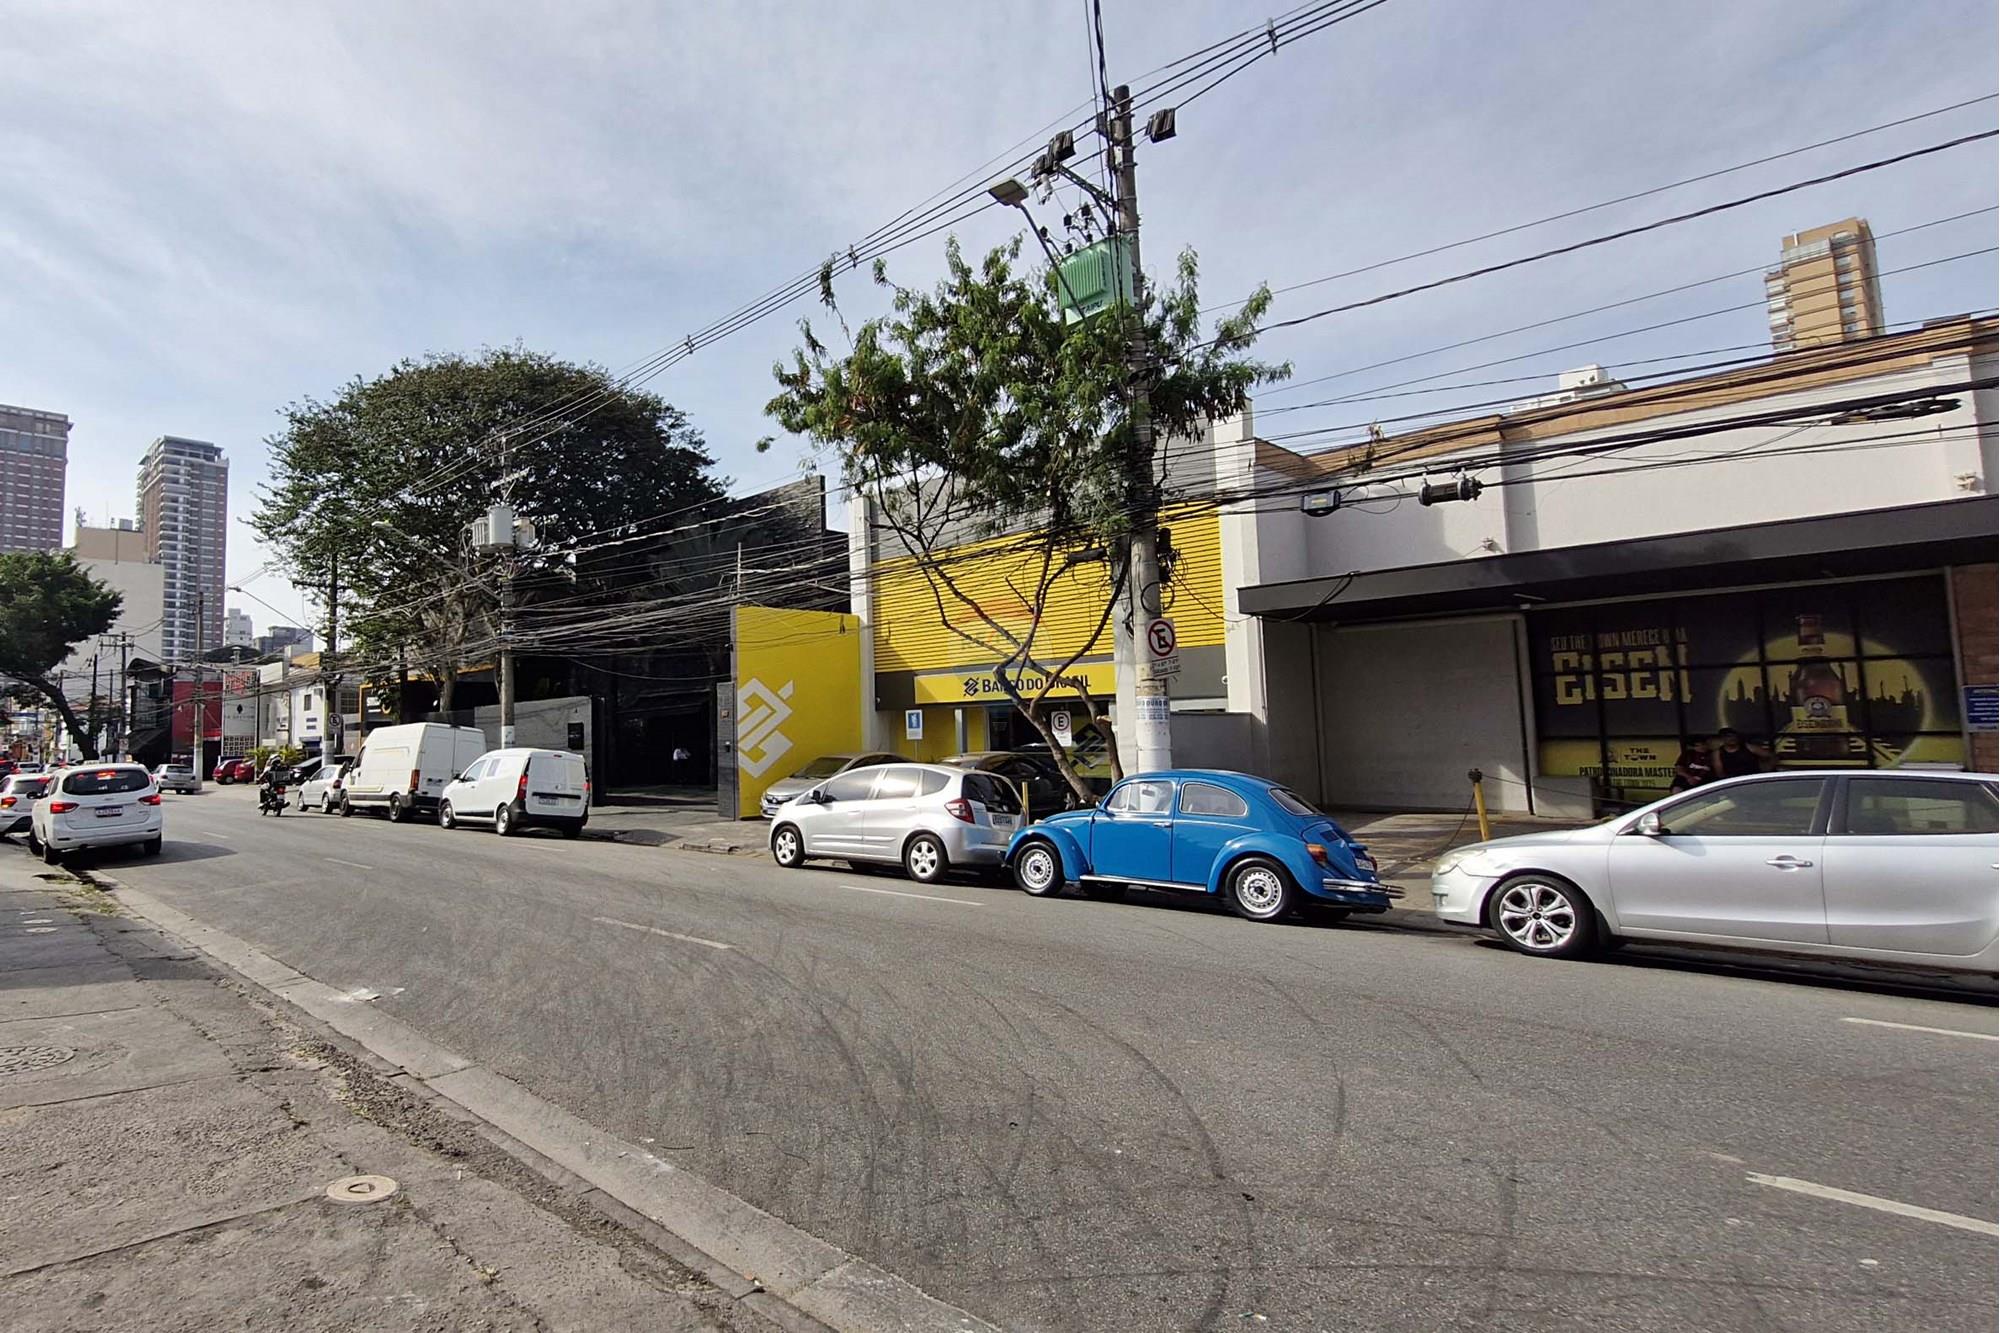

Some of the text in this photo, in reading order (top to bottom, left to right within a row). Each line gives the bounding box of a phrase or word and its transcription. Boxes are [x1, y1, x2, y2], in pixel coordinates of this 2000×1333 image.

[1155, 628, 1168, 648] E
[1587, 632, 1620, 648] OWN
[1663, 627, 1688, 643] UA
[982, 675, 1092, 692] BAO DO RIL
[1058, 716, 1065, 727] E
[1579, 767, 1644, 777] PATROINADORA
